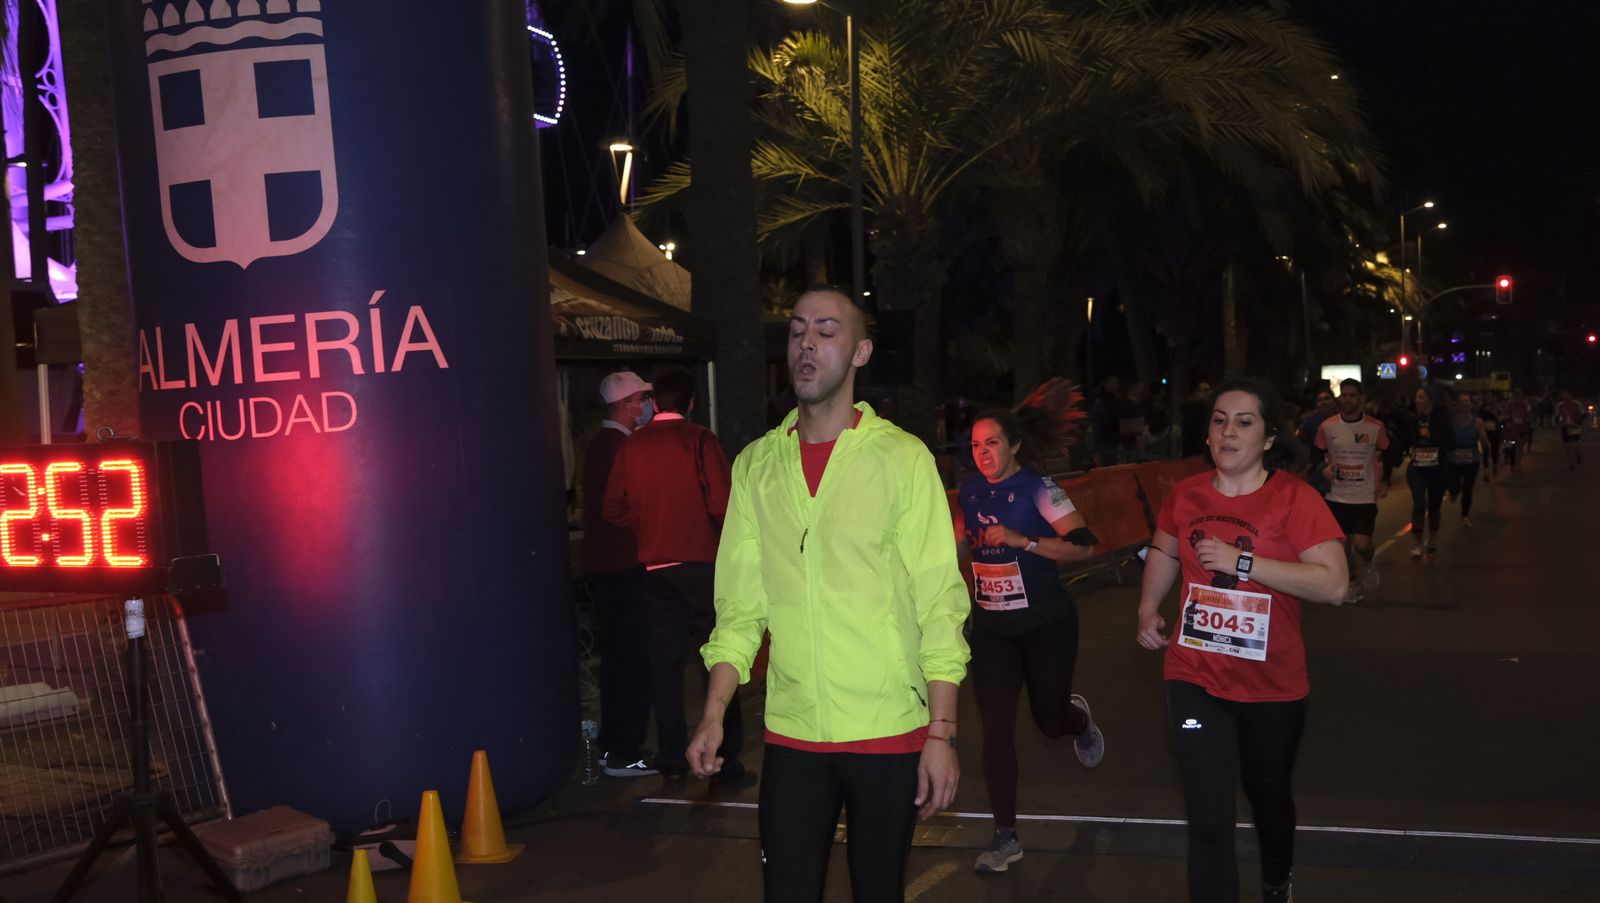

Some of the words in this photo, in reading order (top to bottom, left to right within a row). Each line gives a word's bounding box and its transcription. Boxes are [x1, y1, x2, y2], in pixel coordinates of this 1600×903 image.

[138, 290, 449, 393] ALMERÍA
[179, 390, 359, 442] CIUDAD
[981, 547, 1005, 557] SPORT
[980, 580, 1015, 594] 3453
[1196, 609, 1255, 635] 3045
